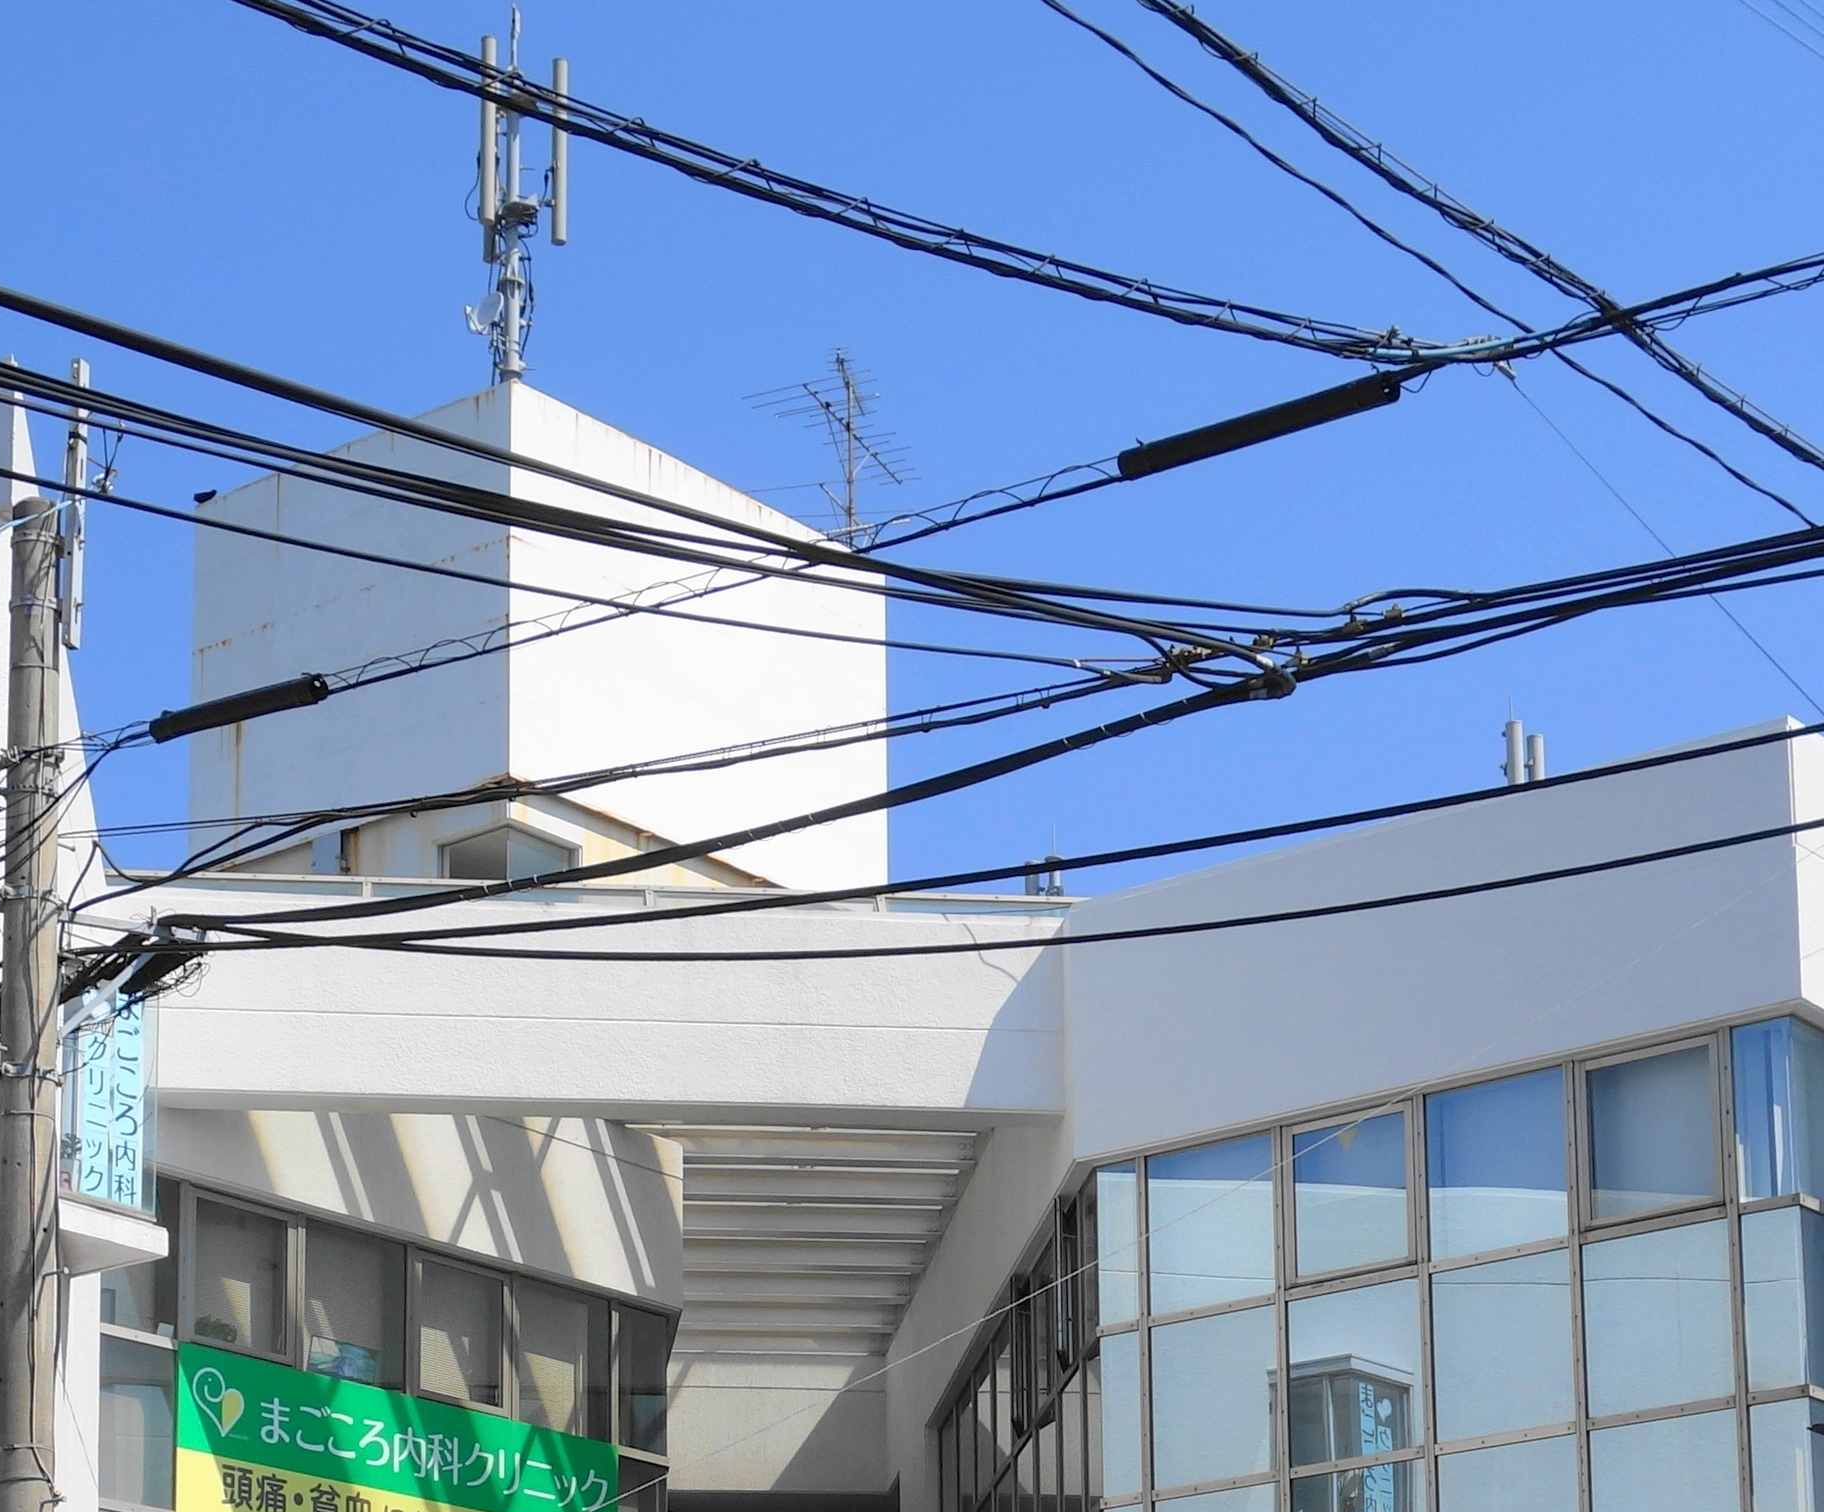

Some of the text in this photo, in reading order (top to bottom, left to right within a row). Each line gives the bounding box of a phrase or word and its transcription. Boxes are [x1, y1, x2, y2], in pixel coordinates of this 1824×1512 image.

[85, 1033, 109, 1192] クリニック
